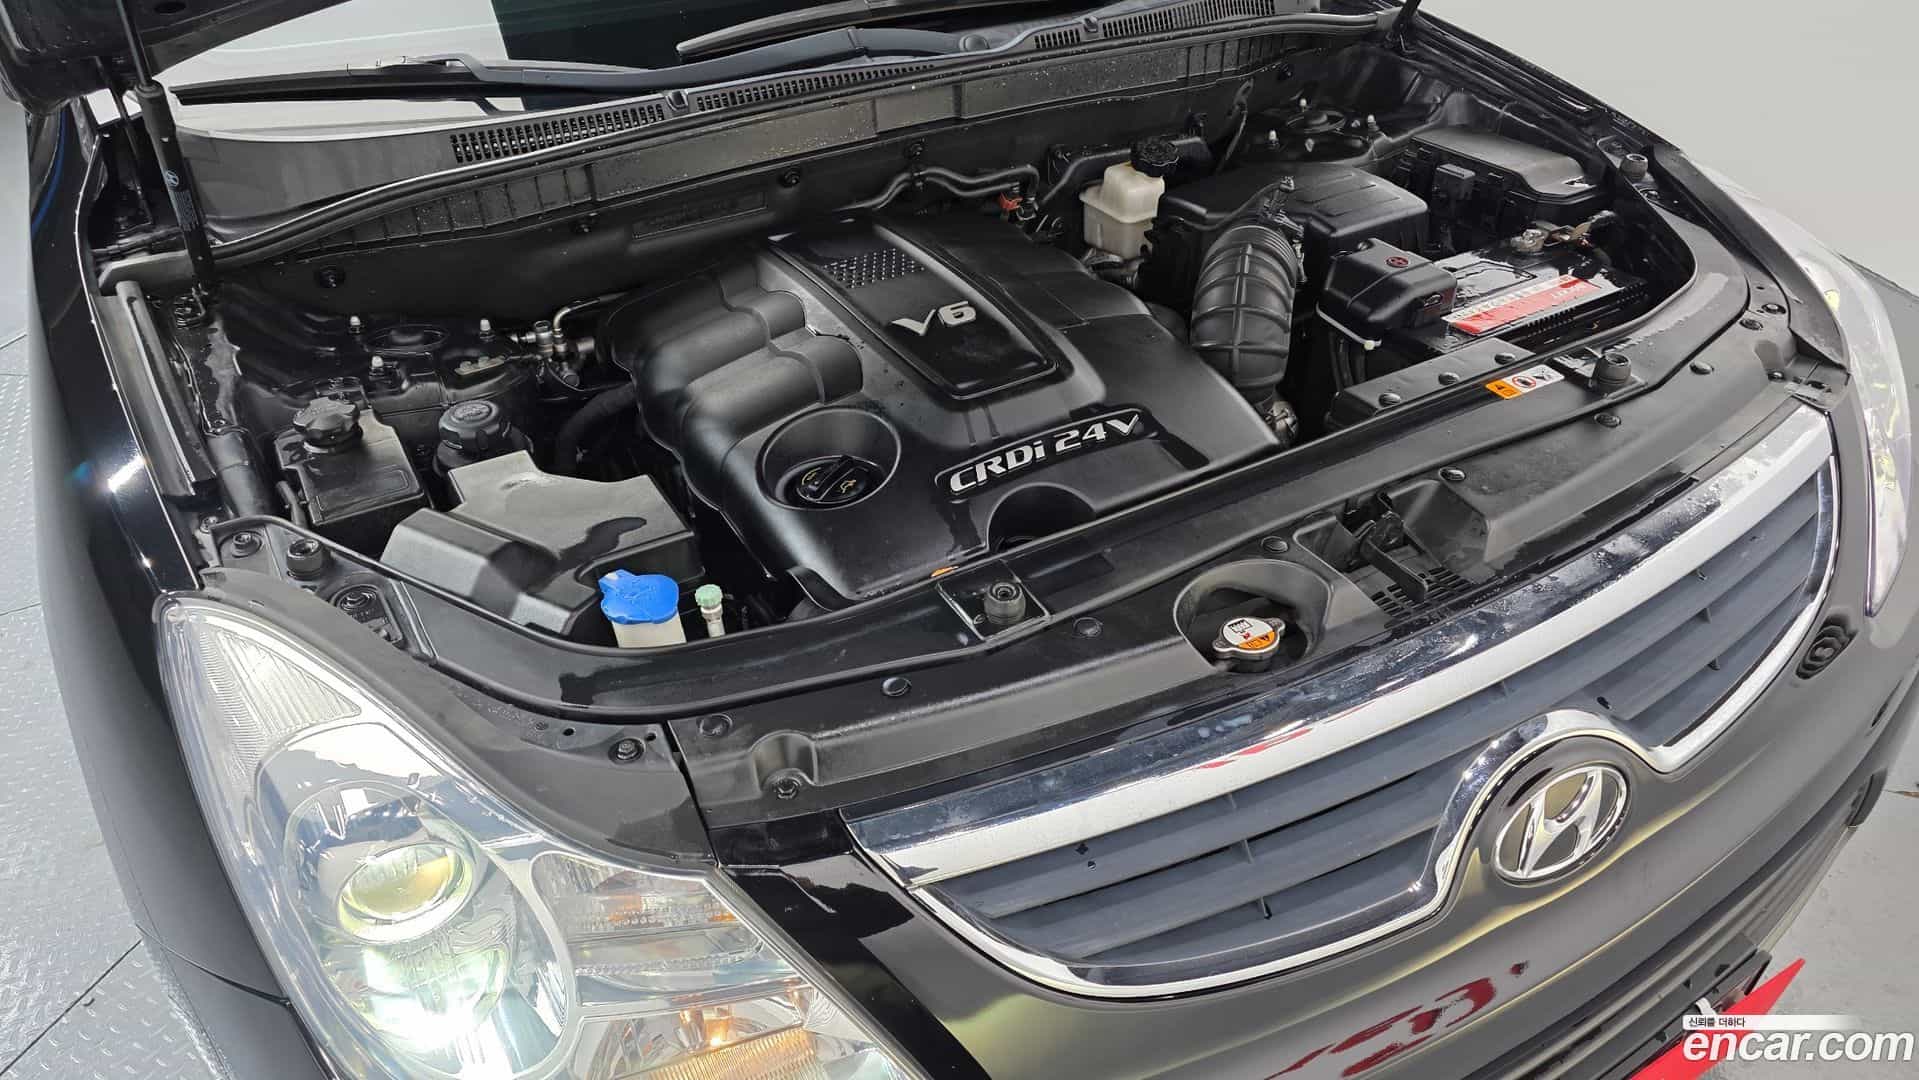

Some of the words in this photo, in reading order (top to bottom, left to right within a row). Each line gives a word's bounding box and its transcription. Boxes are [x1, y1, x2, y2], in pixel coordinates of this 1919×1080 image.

[891, 300, 977, 336] V6
[950, 440, 1045, 493] CRDi
[1054, 414, 1140, 453] 24V
